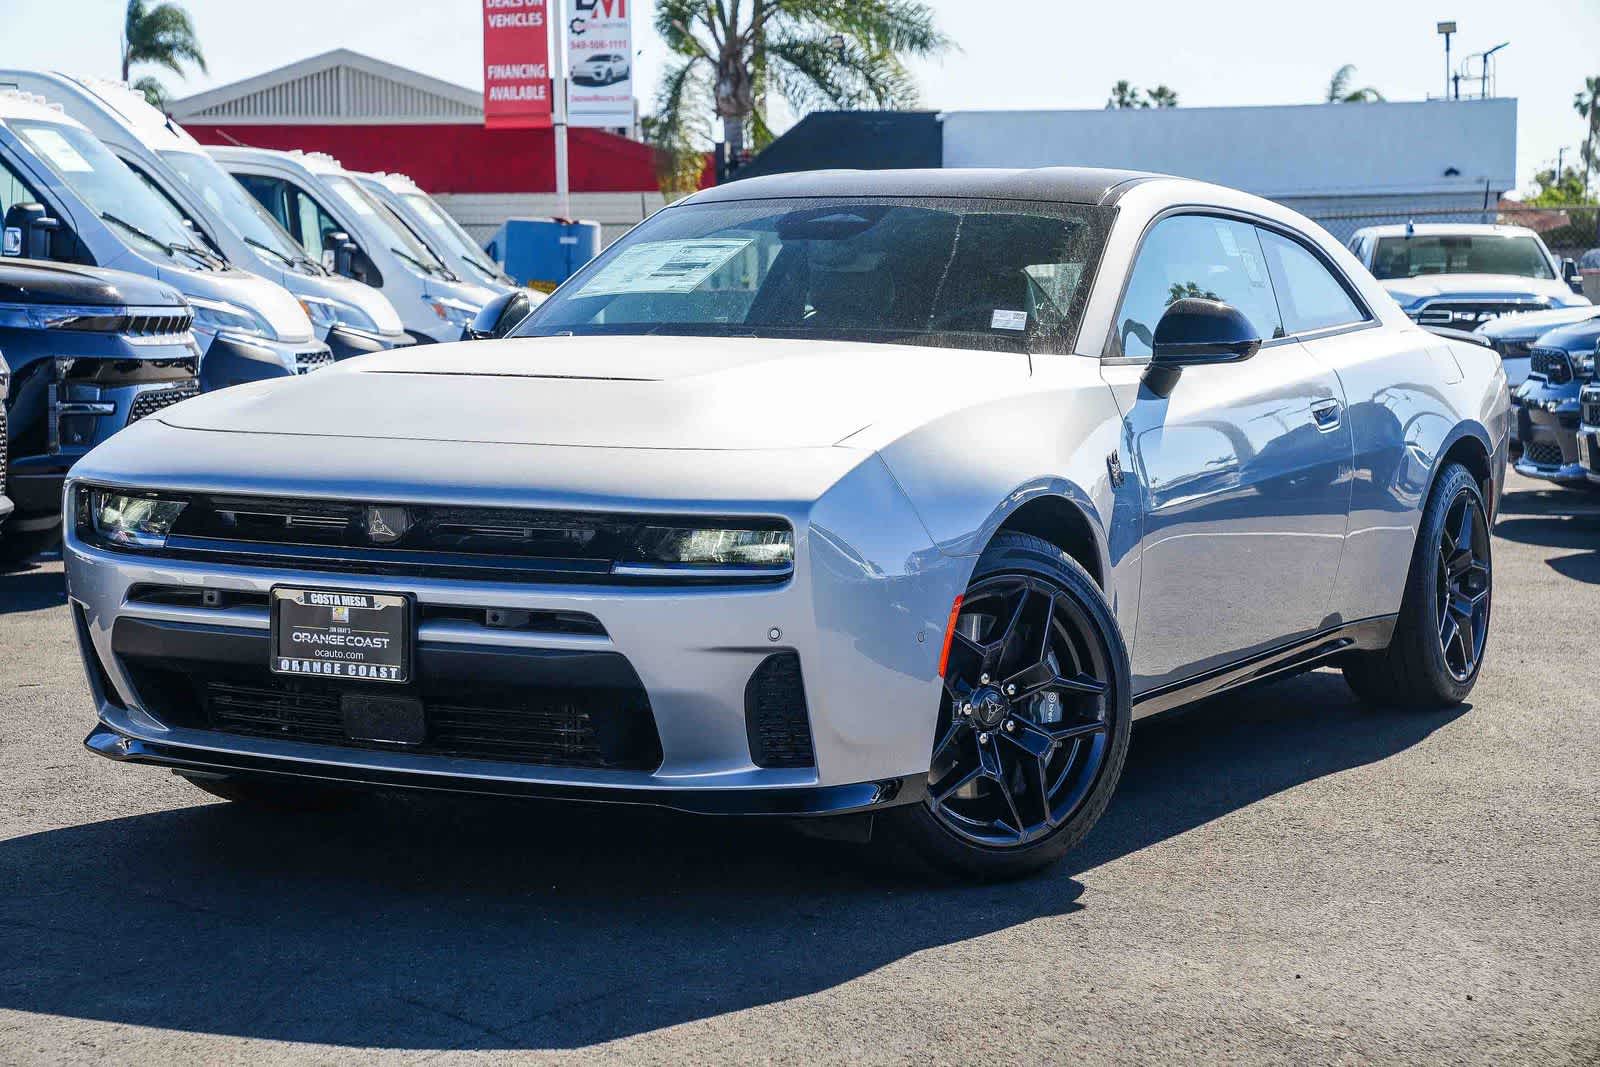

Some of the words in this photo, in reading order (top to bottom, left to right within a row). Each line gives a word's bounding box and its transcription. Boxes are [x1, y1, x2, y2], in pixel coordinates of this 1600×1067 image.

[488, 13, 543, 28] VEHICLES
[487, 64, 545, 80] FINANCING
[489, 85, 546, 101] AVAILABLE
[311, 594, 341, 605] COSTA
[342, 596, 367, 607] MESA
[292, 632, 345, 645] ORANGE
[346, 637, 390, 649] COAST
[315, 649, 364, 660] ocauto.com
[281, 660, 341, 674] ORANGE
[348, 665, 398, 679] COAST
